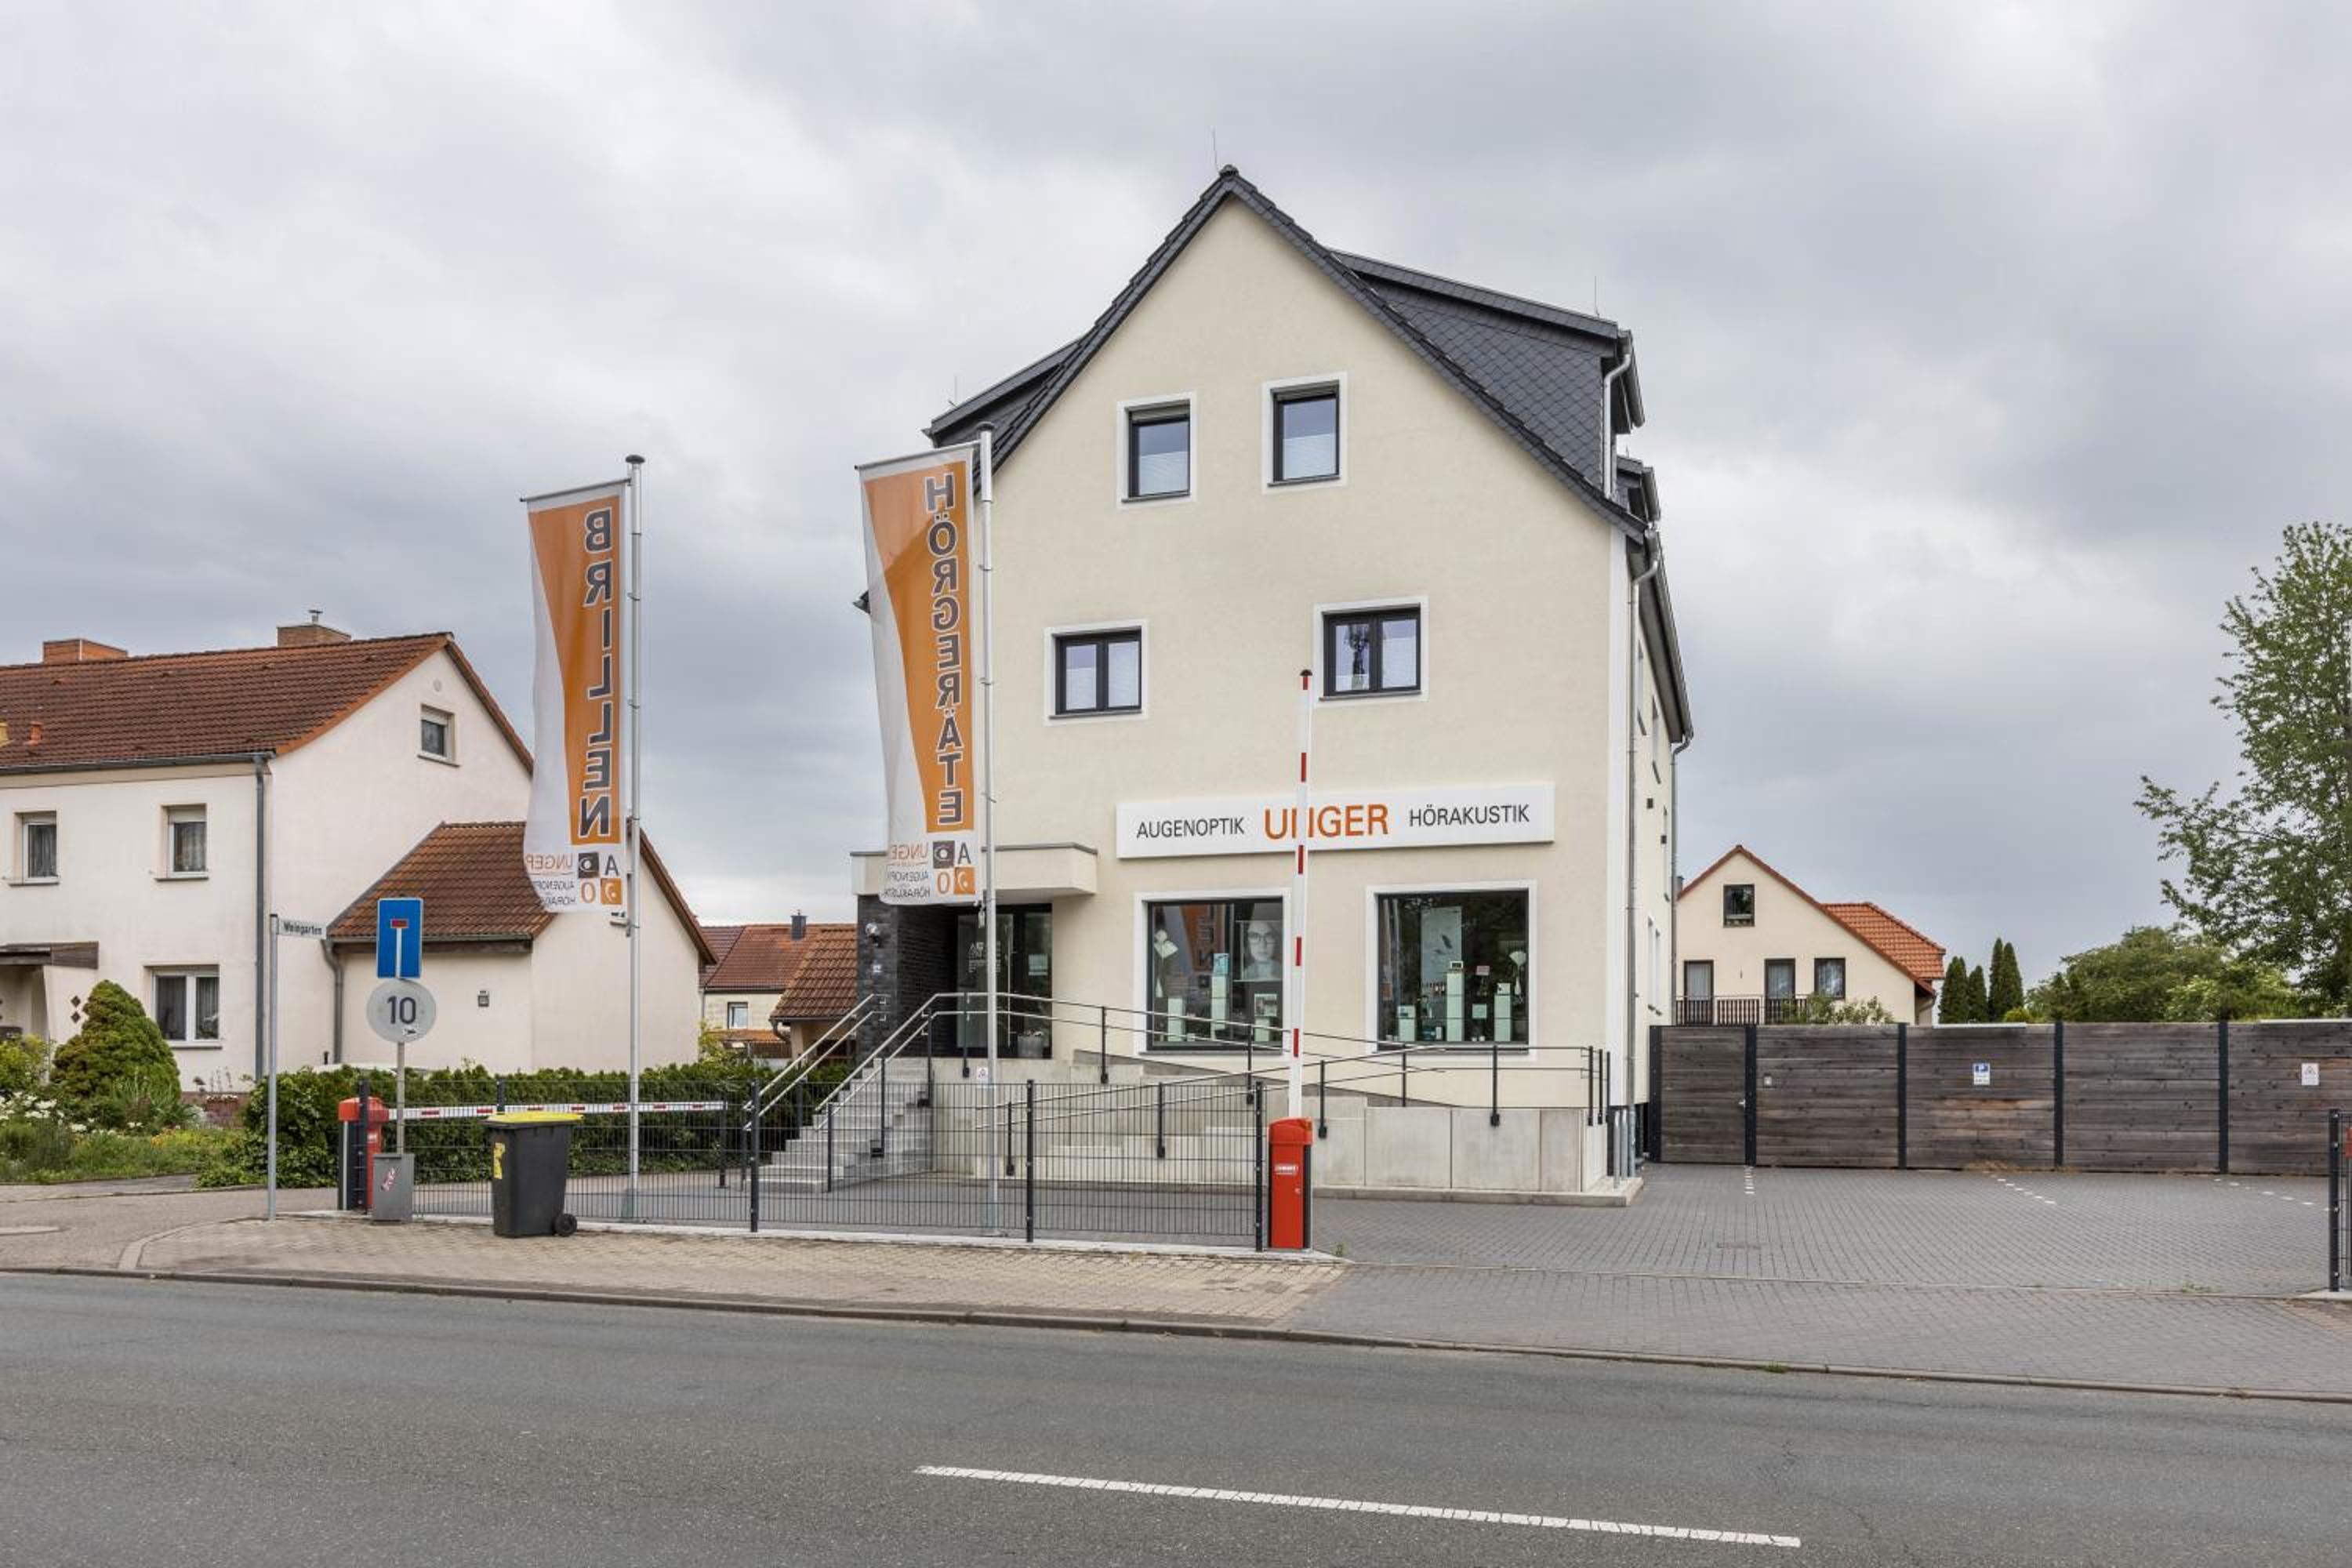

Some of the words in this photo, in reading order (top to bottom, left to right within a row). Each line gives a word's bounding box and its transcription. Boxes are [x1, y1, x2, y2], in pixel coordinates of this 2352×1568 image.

[1136, 817, 1245, 838] AUGENOPTIK
[1410, 804, 1530, 826] HÖRAKUSTIK
[284, 921, 321, 935] Weingarten
[387, 996, 416, 1025] 10
